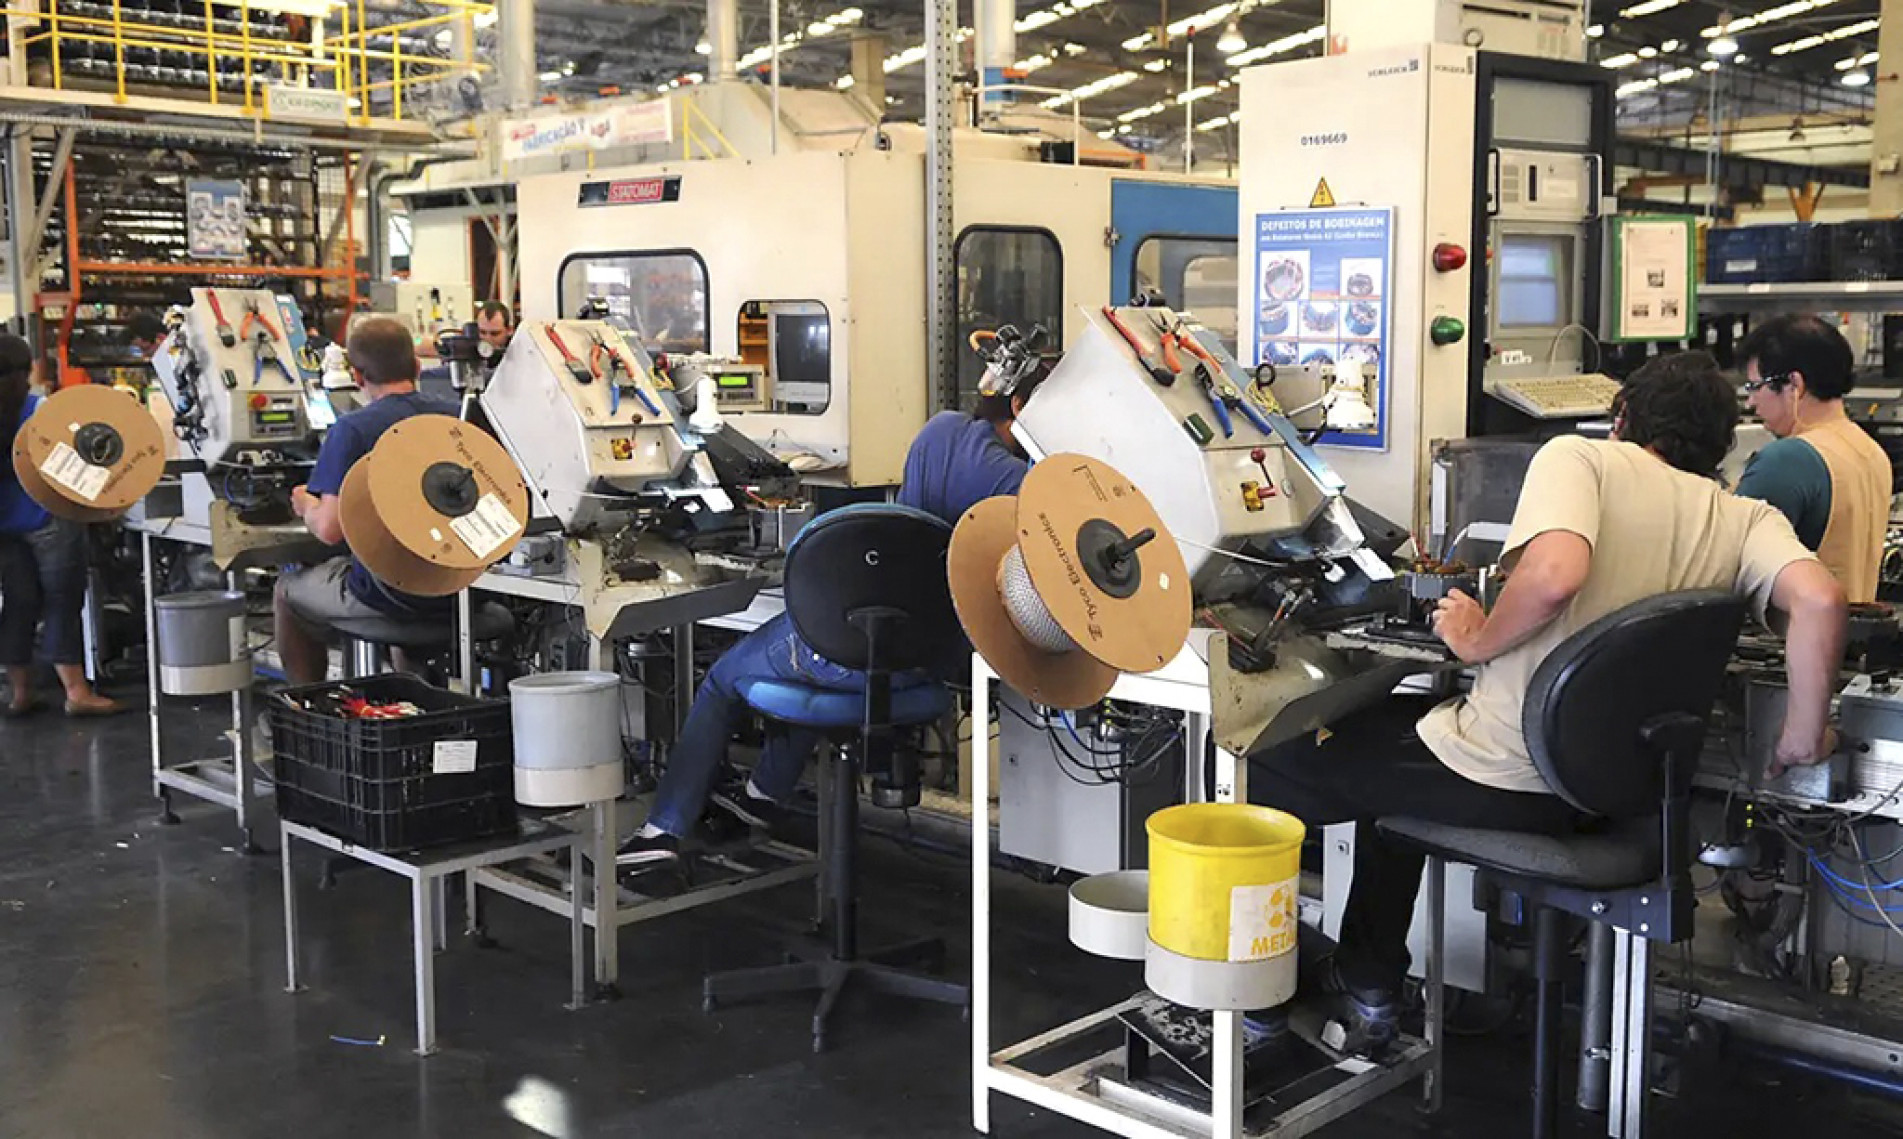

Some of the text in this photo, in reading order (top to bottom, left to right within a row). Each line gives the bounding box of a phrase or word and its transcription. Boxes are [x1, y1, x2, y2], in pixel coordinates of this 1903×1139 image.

[1300, 132, 1348, 146] 0169669
[611, 183, 660, 199] STATOMAT
[1261, 216, 1385, 231] DEFEITOS DE BOBINAGEM
[456, 441, 512, 504] Tyco Electronics
[865, 550, 879, 566] C
[1038, 512, 1096, 619] Tyco Electronics
[1250, 932, 1296, 955] META
